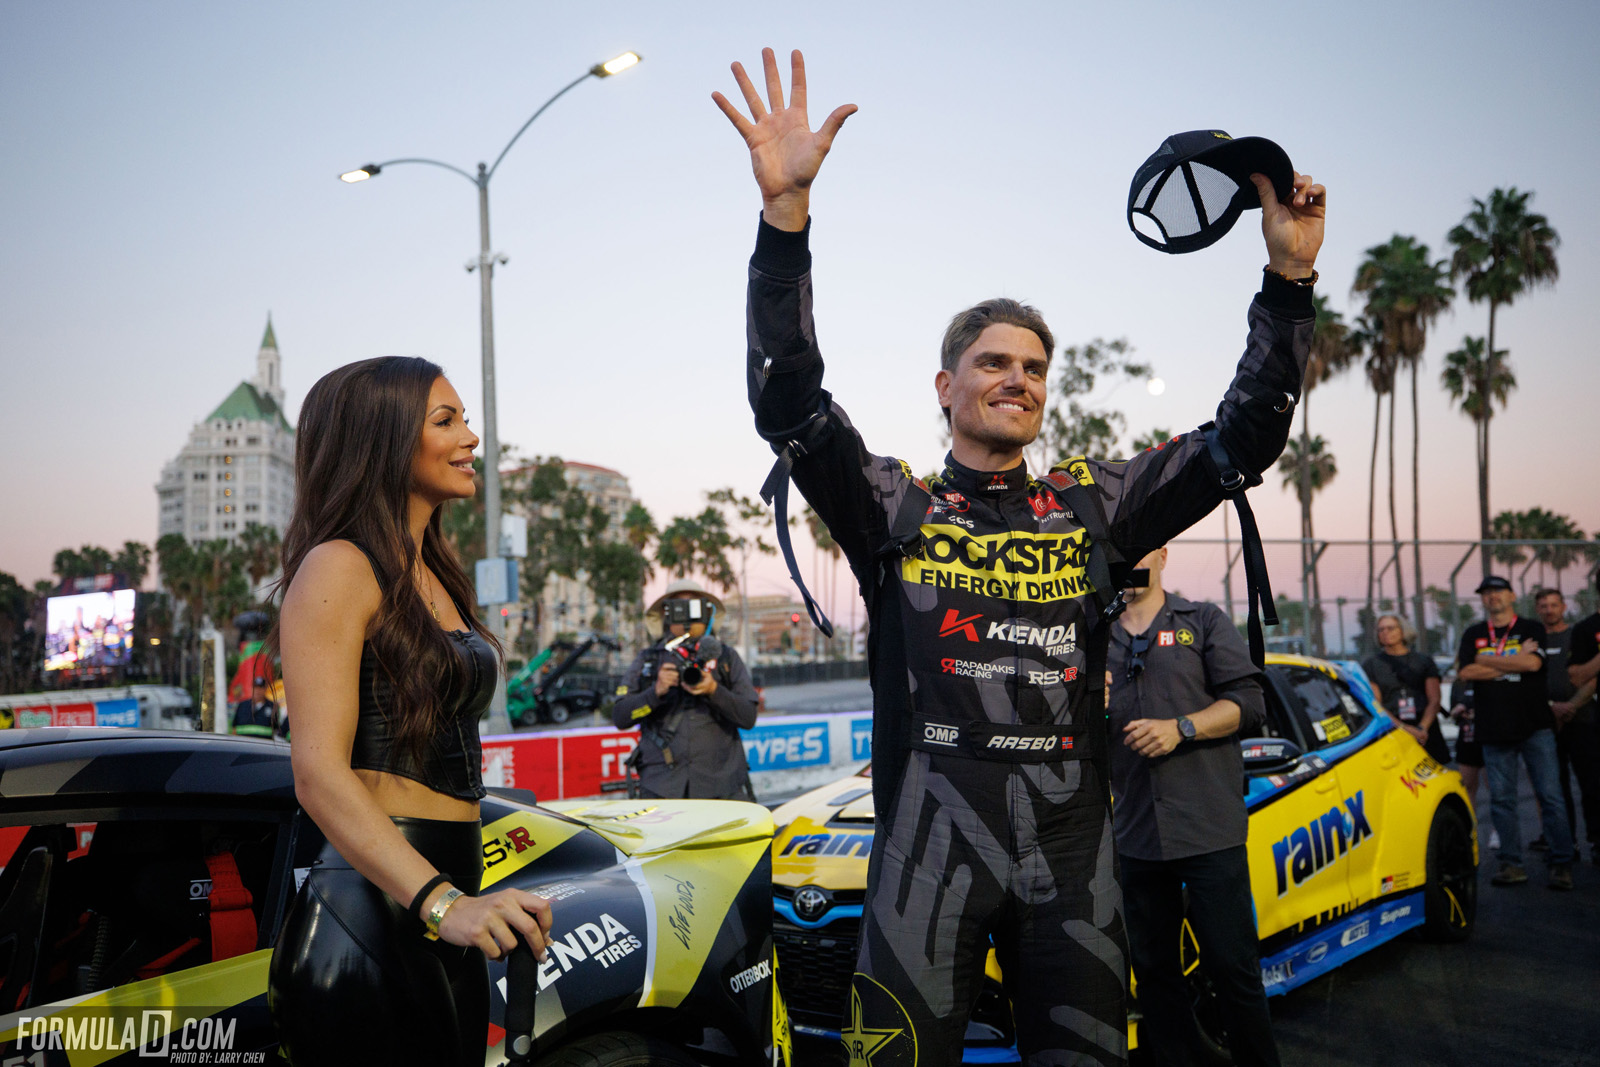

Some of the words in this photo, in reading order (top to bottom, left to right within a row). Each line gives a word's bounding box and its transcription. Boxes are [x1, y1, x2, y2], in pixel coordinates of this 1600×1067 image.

[917, 531, 1092, 575] OCKSTAR
[920, 568, 1021, 600] ENERGY
[1026, 573, 1091, 600] DRINK
[986, 621, 1077, 647] KENDA
[1045, 643, 1076, 657] TIRES
[955, 659, 1016, 675] PAPADAKIS
[955, 668, 993, 679] RACING
[924, 726, 959, 742] OMP
[496, 912, 631, 1005] ENDA
[594, 934, 643, 969] TIRES
[729, 959, 772, 994] OTTERBOX
